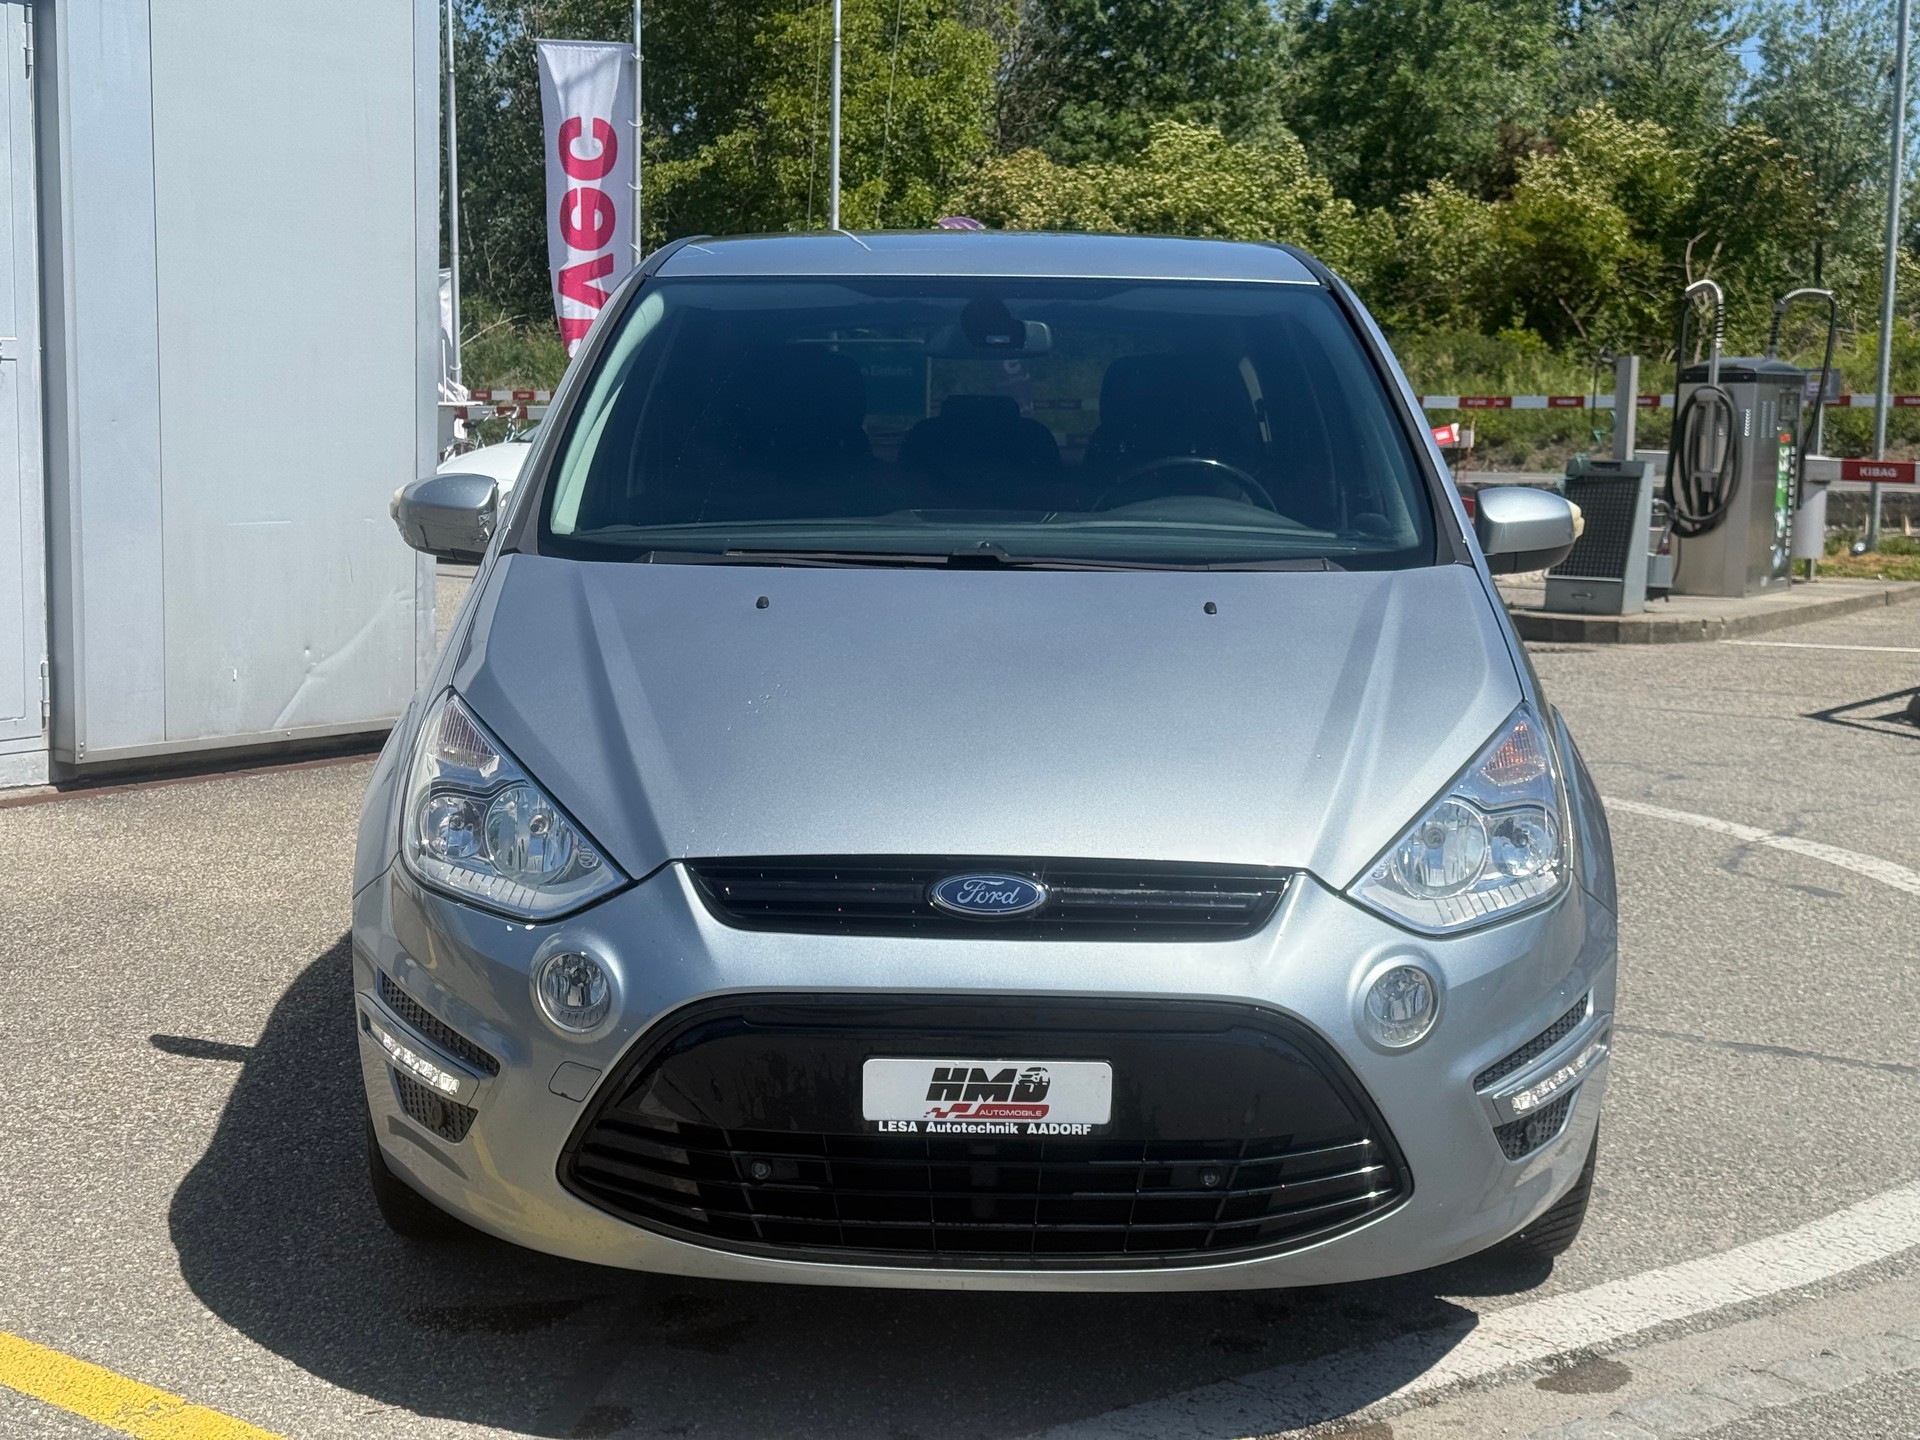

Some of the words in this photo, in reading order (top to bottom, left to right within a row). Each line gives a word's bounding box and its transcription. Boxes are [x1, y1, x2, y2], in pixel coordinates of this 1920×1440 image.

[1859, 466, 1897, 478] KIBAG
[956, 879, 1021, 905] Ford
[979, 1109, 1043, 1117] AUTOMOBILE
[878, 1120, 918, 1133] LESA
[925, 1121, 1019, 1135] Autotechnik
[1026, 1122, 1092, 1136] AADORF
